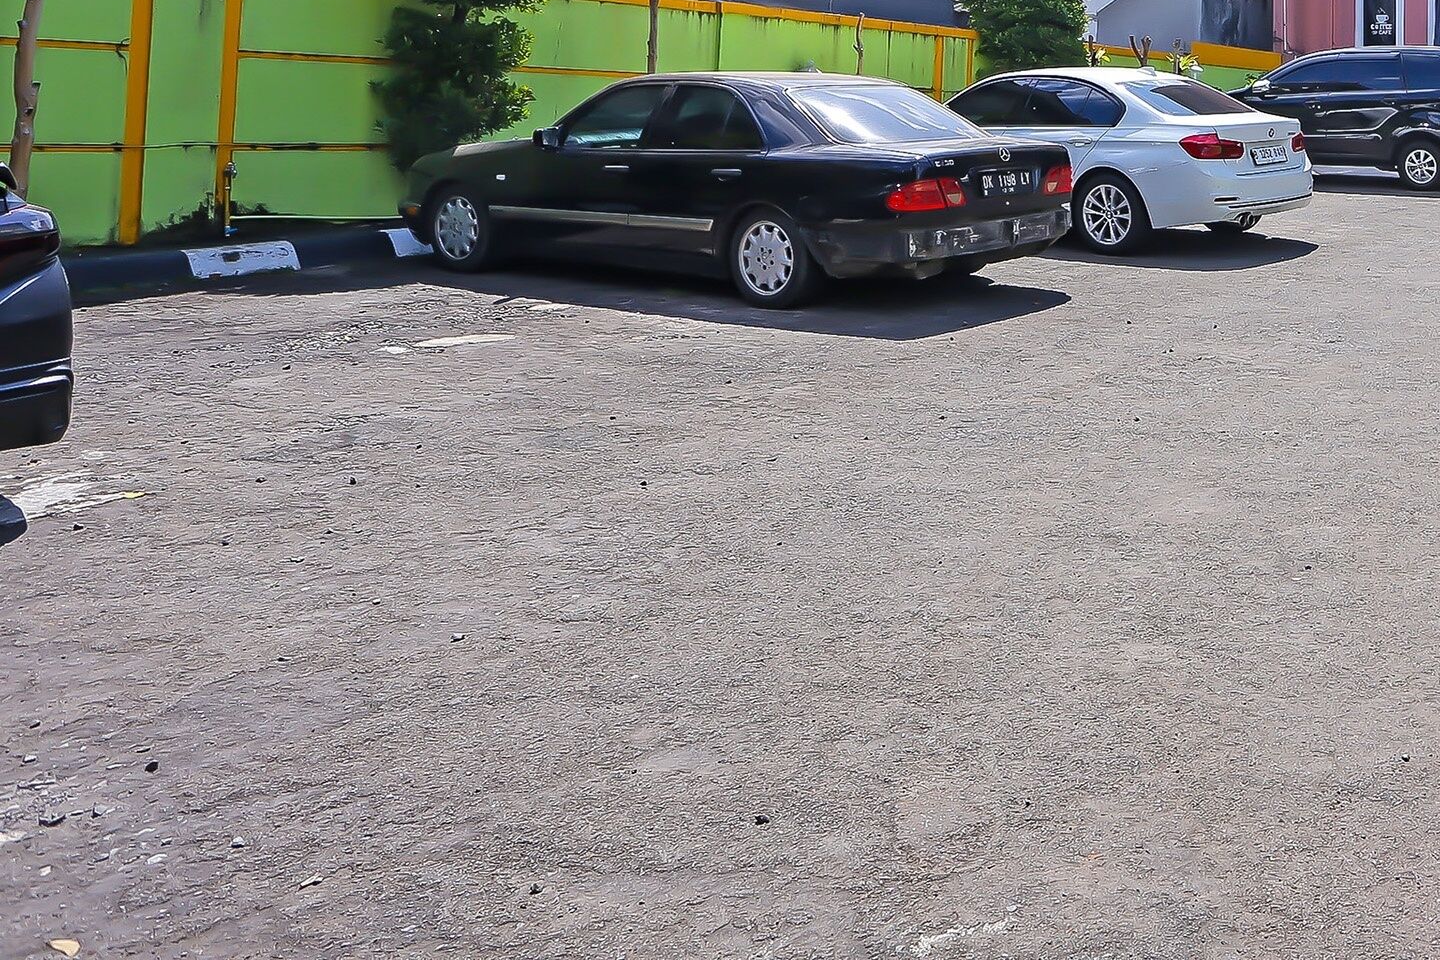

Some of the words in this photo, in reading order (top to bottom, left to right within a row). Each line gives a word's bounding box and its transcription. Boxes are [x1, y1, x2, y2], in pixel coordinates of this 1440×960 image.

[982, 175, 994, 189] DK
[998, 173, 1017, 187] 1198
[1020, 171, 1030, 185] LY
